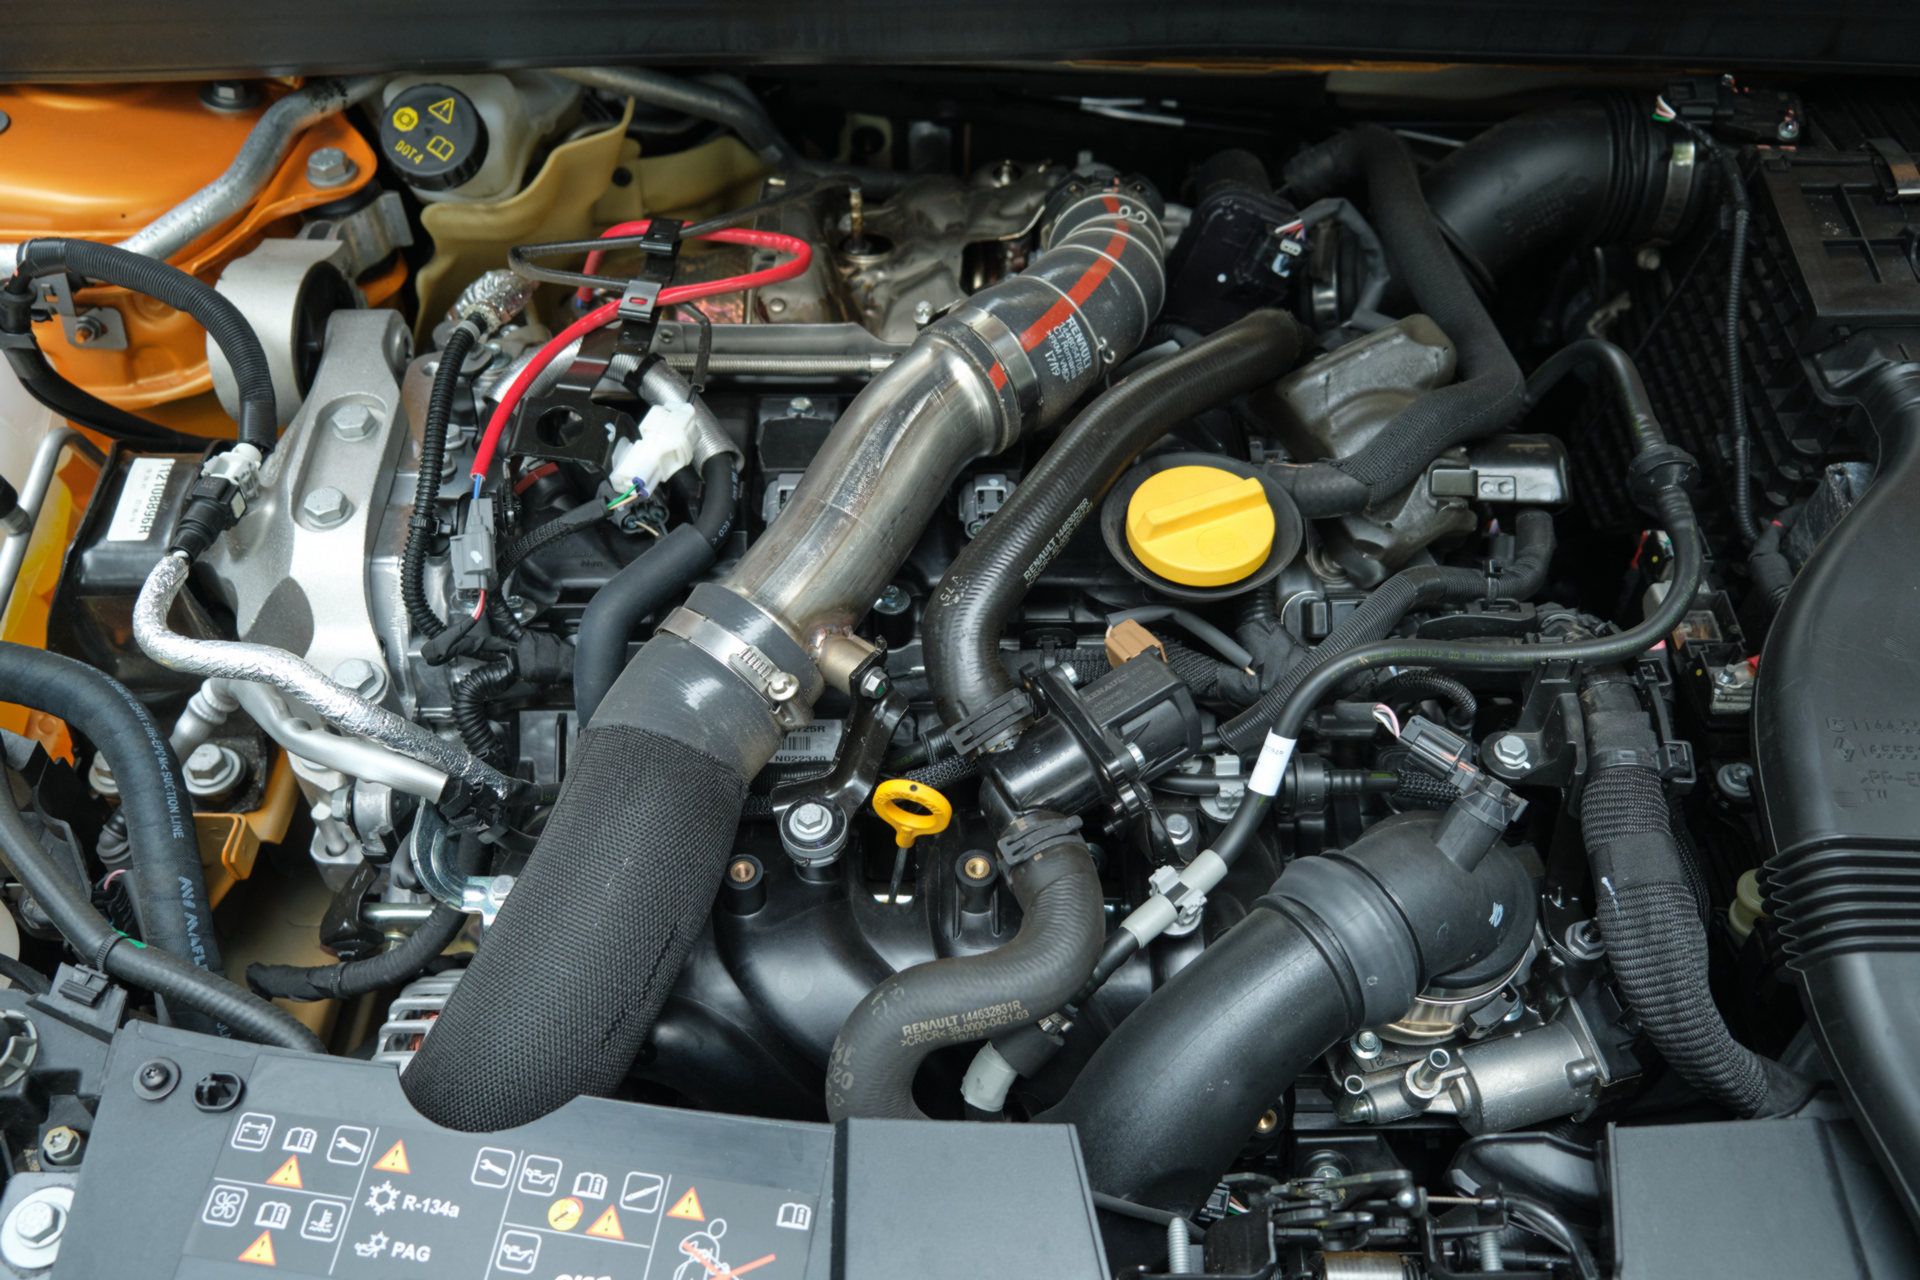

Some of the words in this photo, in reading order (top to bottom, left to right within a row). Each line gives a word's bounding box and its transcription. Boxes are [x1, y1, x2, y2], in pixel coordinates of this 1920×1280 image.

[1066, 313, 1092, 369] RENAULT
[1023, 537, 1055, 580] RENAULT
[161, 770, 180, 813] SUCTION
[170, 813, 185, 839] LINE
[902, 1015, 959, 1036] RENAULT
[961, 1000, 1021, 1023] 144632831R
[402, 1195, 460, 1218] R-134a
[391, 1242, 431, 1262] PAG
